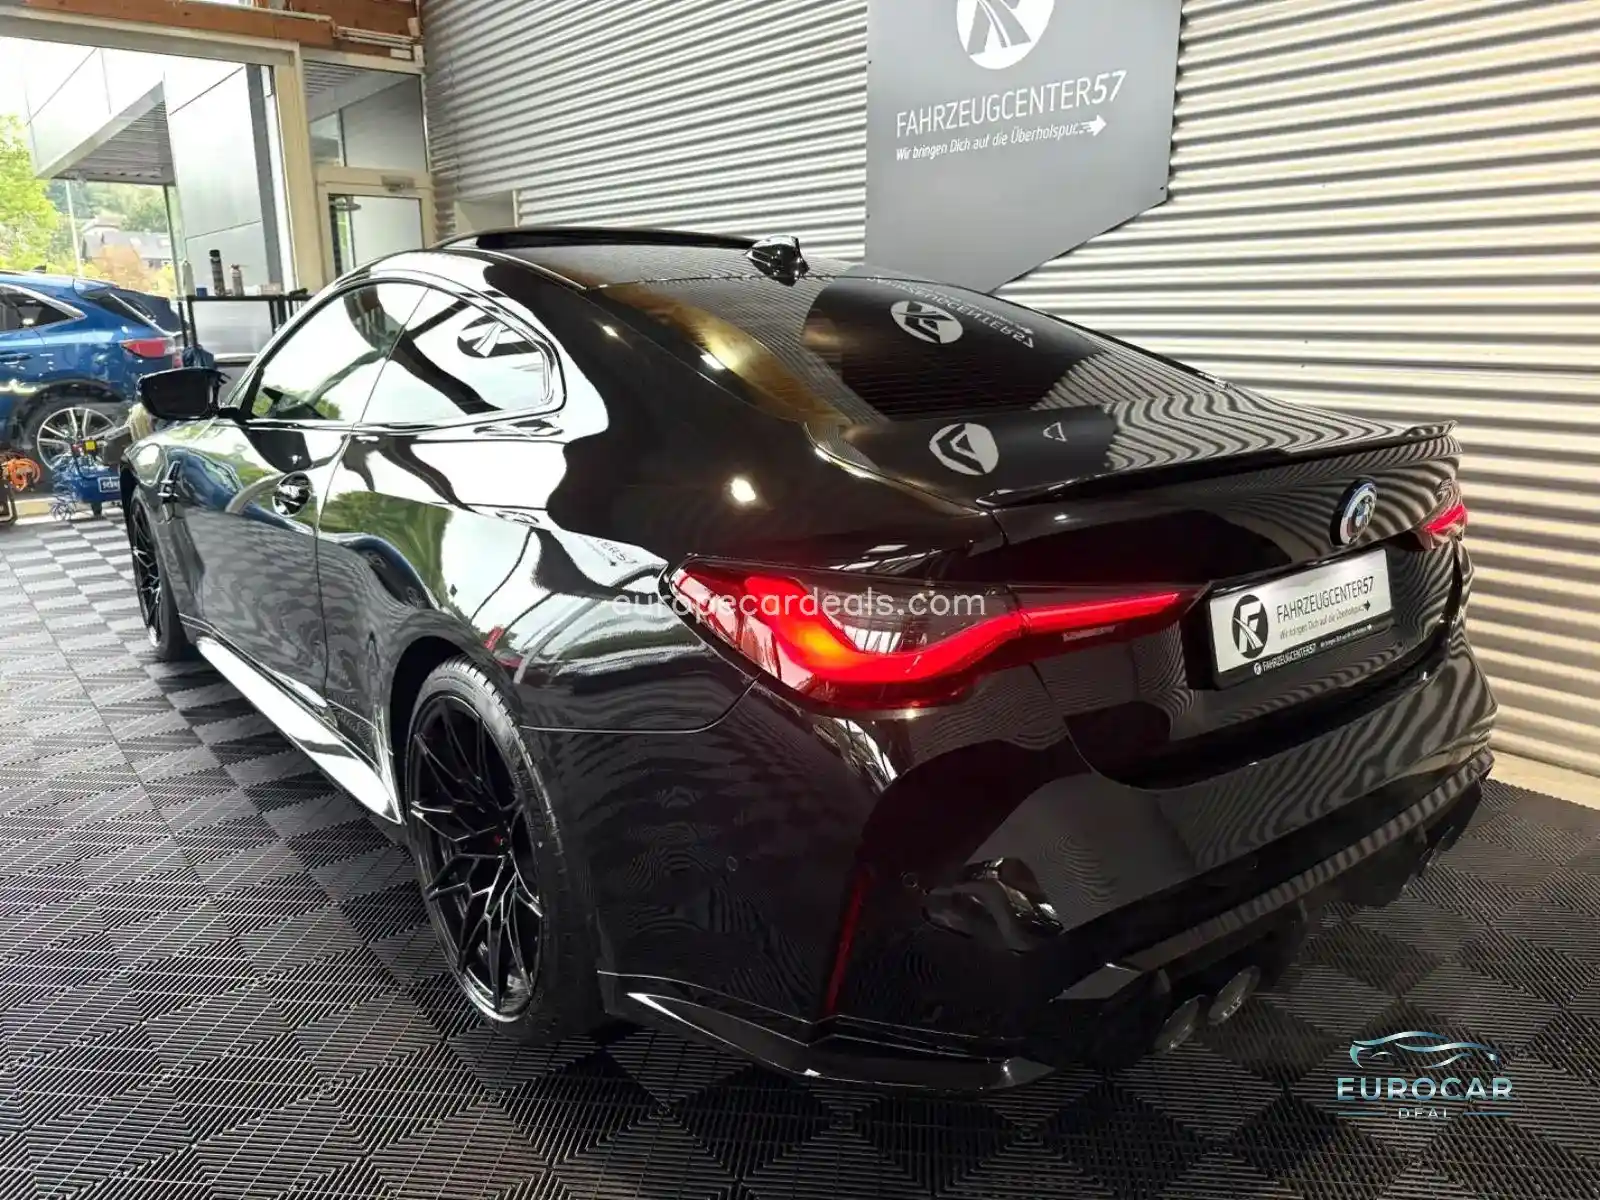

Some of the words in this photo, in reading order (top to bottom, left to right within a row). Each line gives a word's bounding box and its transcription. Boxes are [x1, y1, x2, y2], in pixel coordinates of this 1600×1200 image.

[896, 69, 1127, 138] FAHRZEUGCENTER57
[896, 147, 911, 161] Wir
[912, 143, 948, 160] bringen
[949, 137, 971, 154] Dich
[973, 133, 990, 150] auf
[992, 130, 1008, 147] die
[1276, 575, 1374, 624] FAHRZEUGCENTER57
